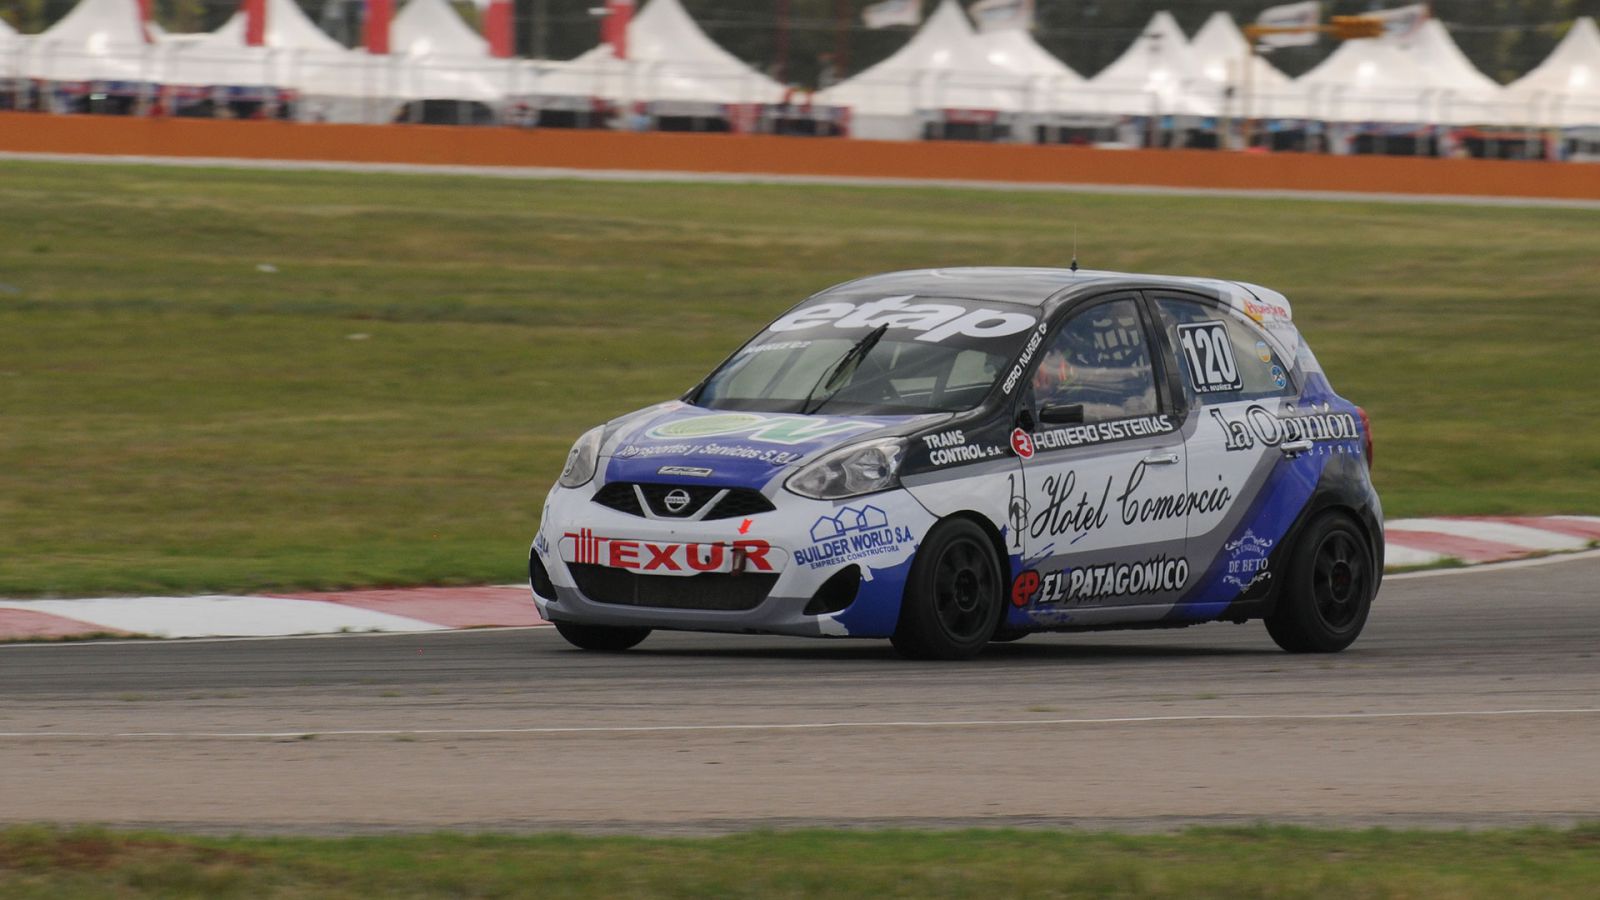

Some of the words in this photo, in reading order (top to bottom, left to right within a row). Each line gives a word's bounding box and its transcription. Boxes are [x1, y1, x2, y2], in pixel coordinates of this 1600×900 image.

[769, 294, 1036, 343] etap
[1182, 326, 1237, 385] 120
[1002, 364, 1023, 395] GERO
[922, 429, 966, 450] TRANS
[1033, 424, 1100, 450] ROMERO
[1099, 414, 1174, 441] SISTEMAS
[698, 443, 763, 459] Servicios
[929, 444, 986, 466] CONTROL
[1031, 470, 1113, 538] Hotel
[1116, 459, 1231, 526] Comercio
[608, 539, 774, 571] EXUR
[793, 538, 851, 566] BUILDER
[850, 528, 893, 552] WORLD
[894, 525, 914, 544] S.A.
[810, 557, 846, 570] EMPRESA
[846, 544, 900, 562] CONSTRUCTORA
[1228, 560, 1240, 573] DE
[1242, 557, 1269, 572] BETO
[1039, 572, 1065, 602] EL
